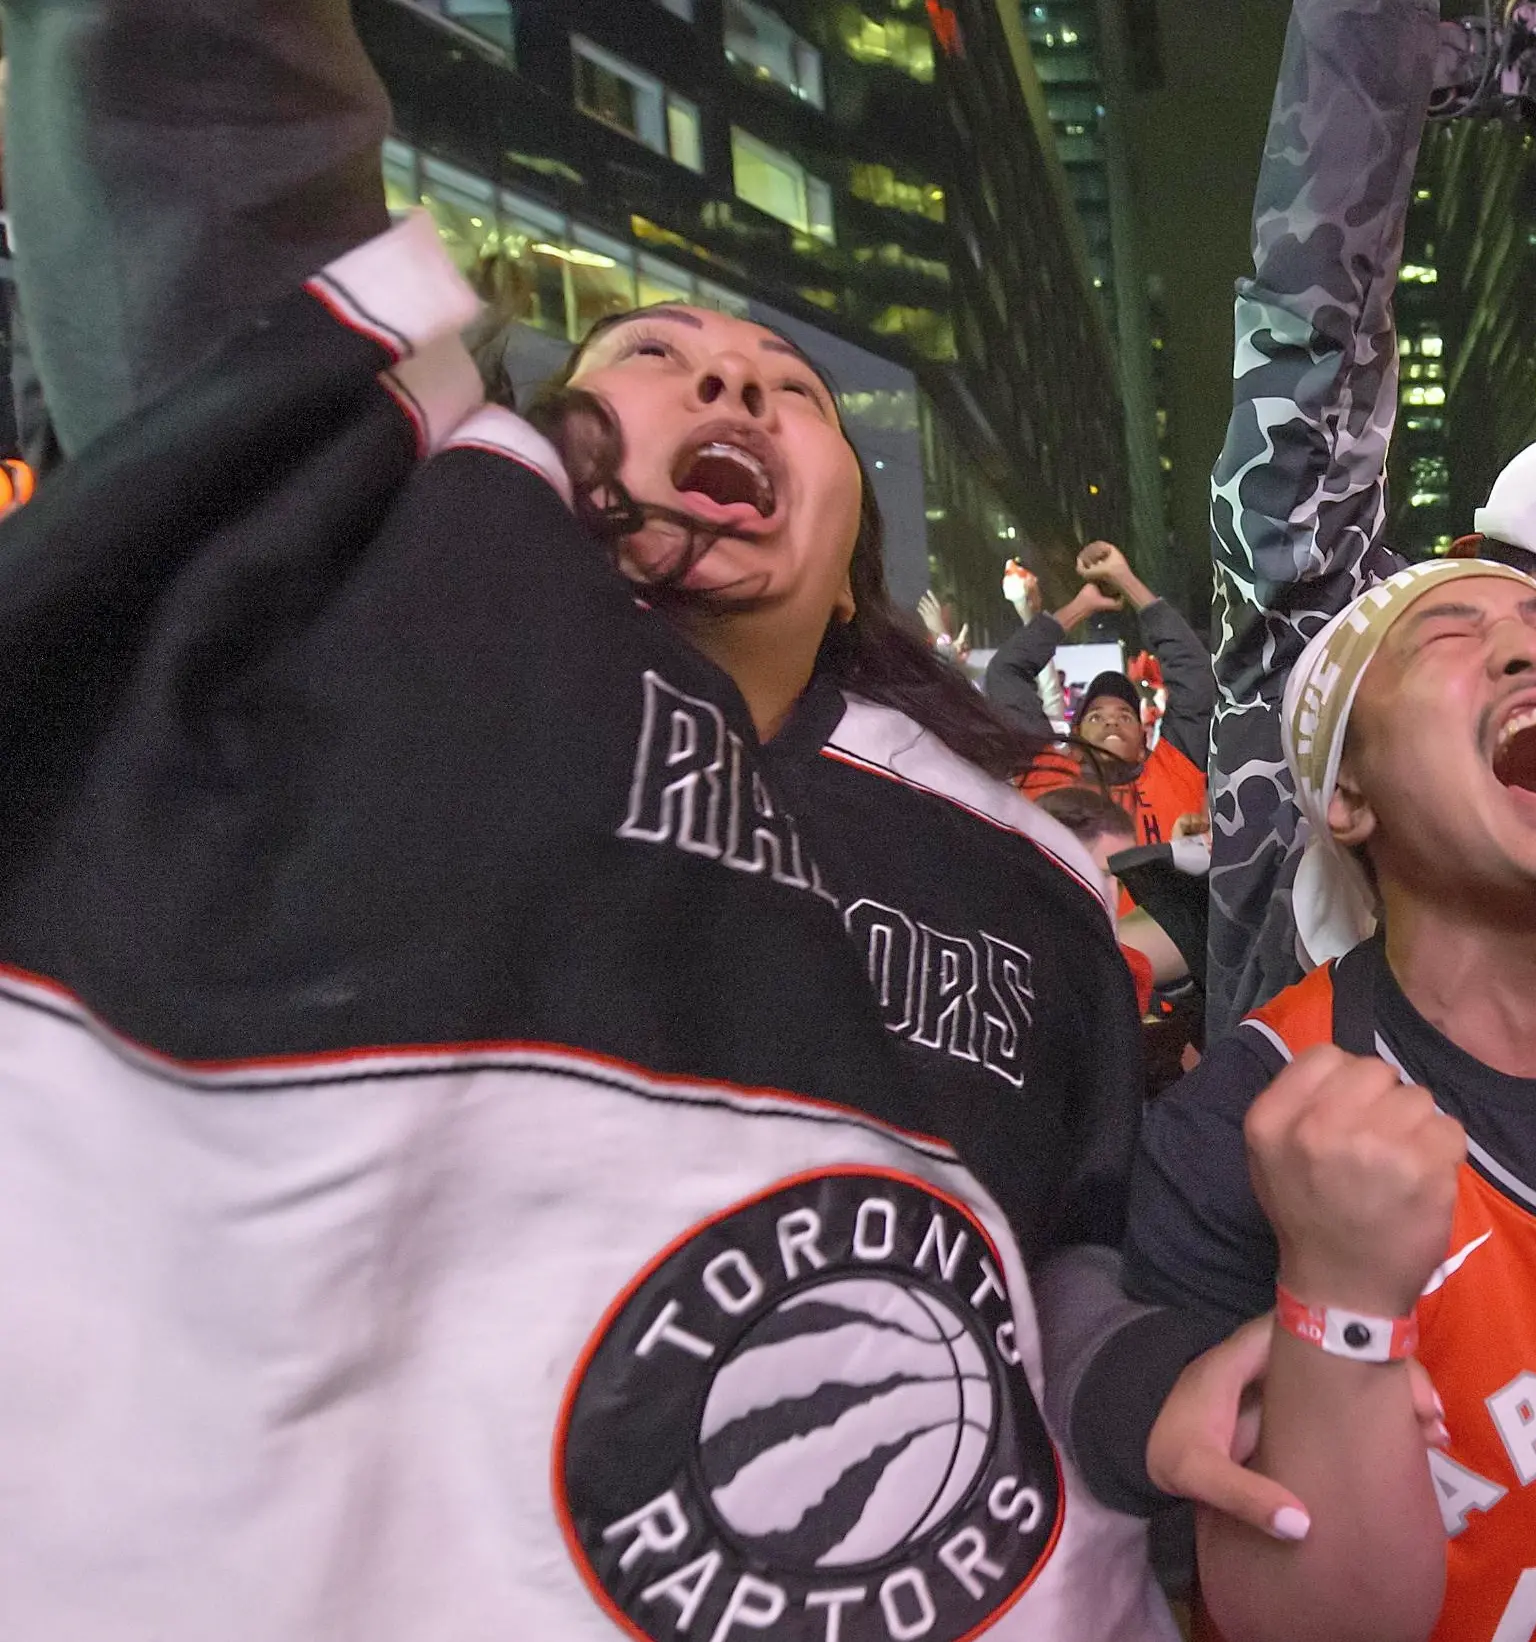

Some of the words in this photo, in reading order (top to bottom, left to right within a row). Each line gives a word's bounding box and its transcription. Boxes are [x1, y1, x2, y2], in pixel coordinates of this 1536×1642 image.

[615, 669, 1036, 1090] RAORS
[635, 1198, 1021, 1366] TORONTO
[602, 1475, 1043, 1642] RAPTORS
